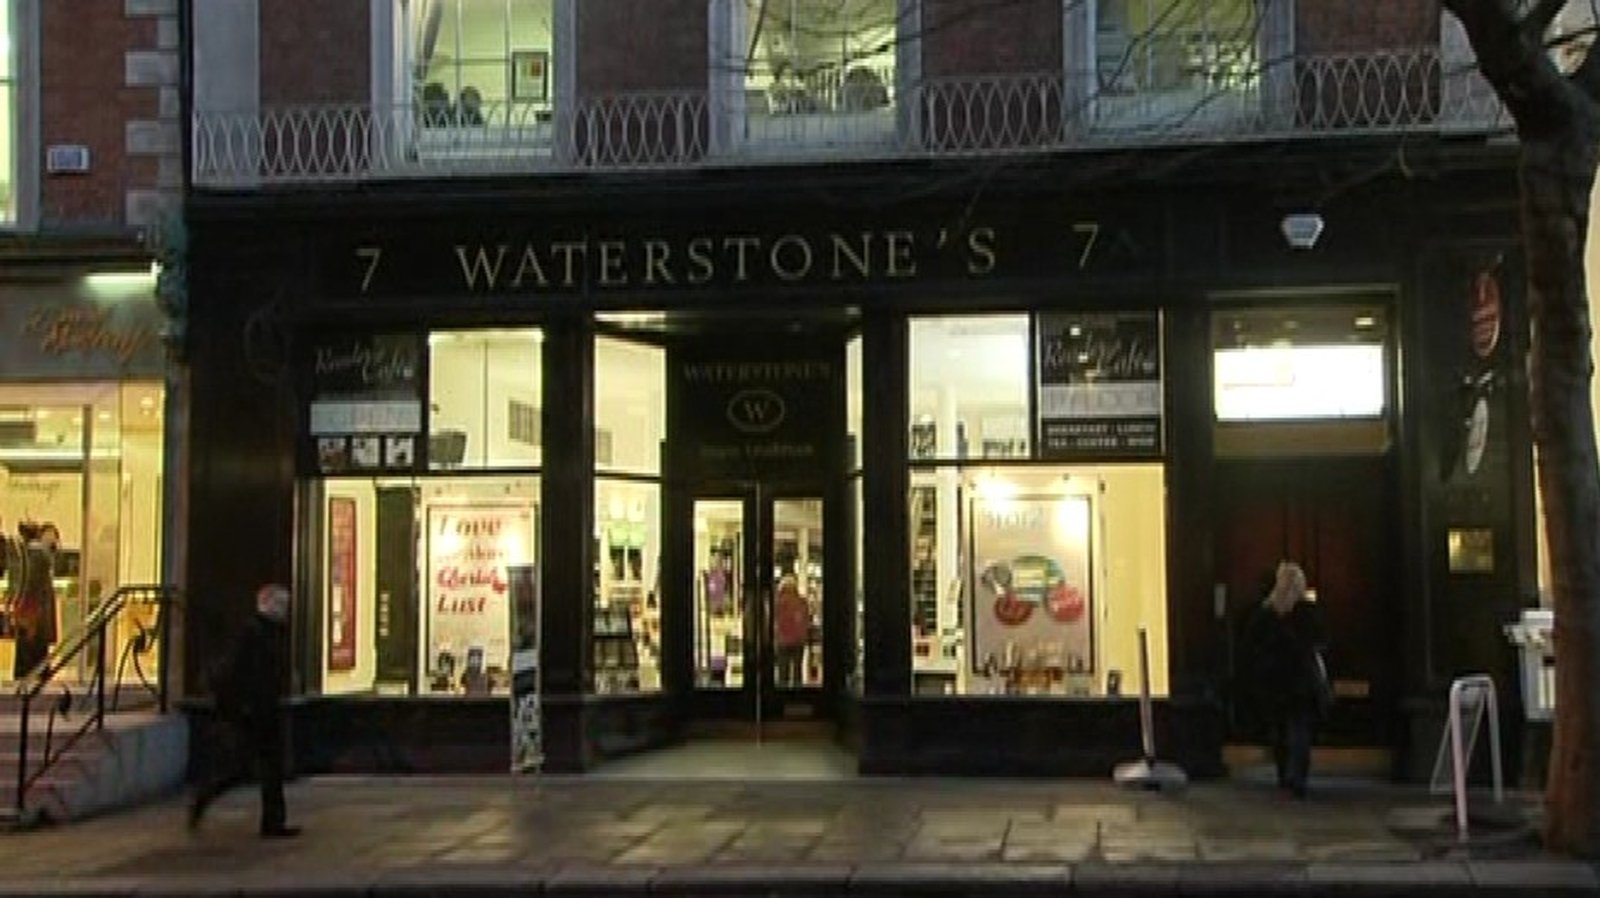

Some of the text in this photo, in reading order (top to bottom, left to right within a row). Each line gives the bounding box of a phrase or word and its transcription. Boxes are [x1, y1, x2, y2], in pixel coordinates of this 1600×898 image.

[356, 247, 382, 291] 7
[454, 227, 996, 290] WATERSTONE'S
[743, 399, 770, 422] W
